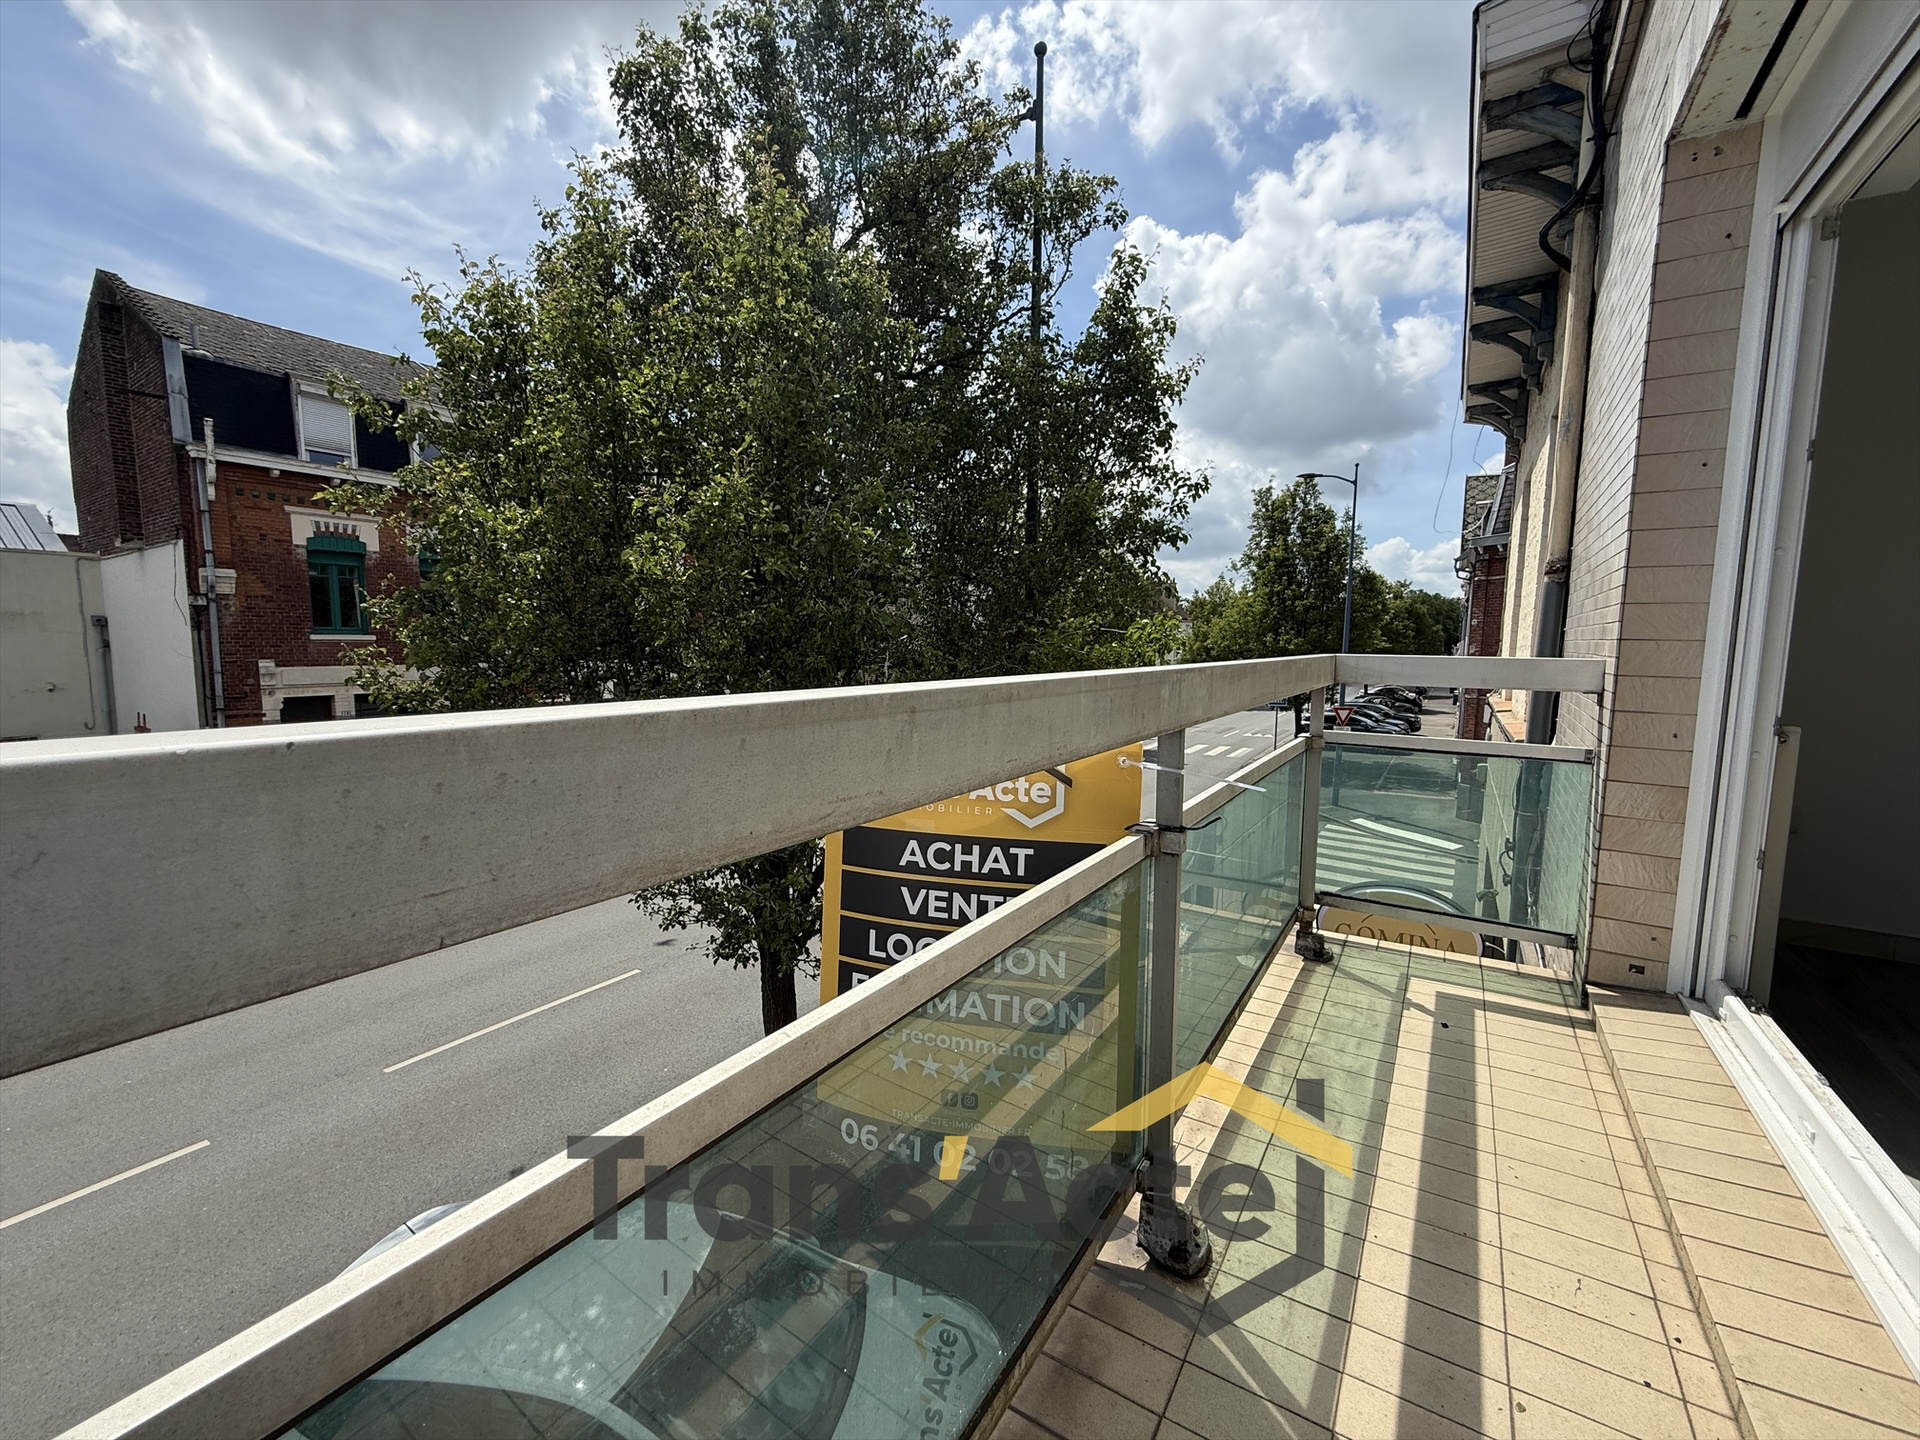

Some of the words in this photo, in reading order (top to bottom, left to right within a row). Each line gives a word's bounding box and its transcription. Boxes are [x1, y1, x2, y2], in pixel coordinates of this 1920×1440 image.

[917, 802, 993, 816] OBILIER
[899, 840, 1035, 876] ACHAT
[901, 886, 1014, 921] VENT
[901, 1027, 1061, 1062] recommande
[840, 1117, 879, 1151] 06
[888, 1132, 921, 1164] 41
[933, 1140, 977, 1172] 02
